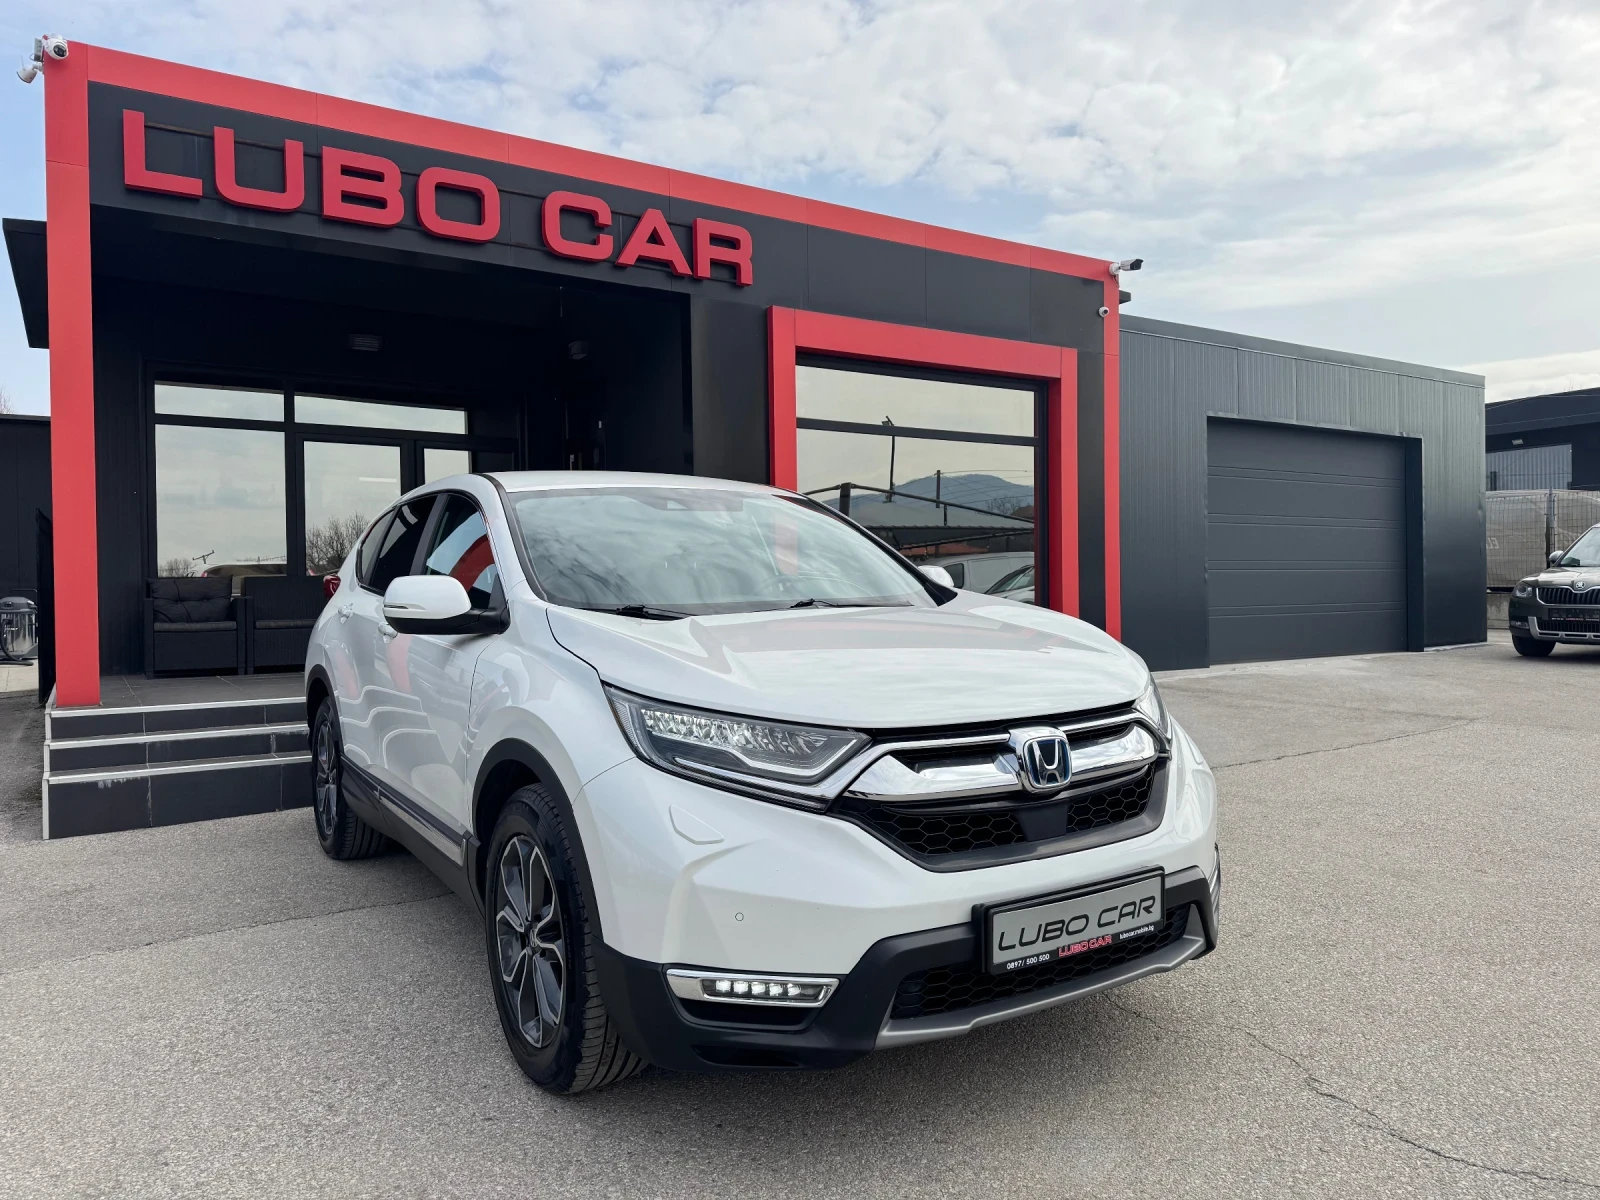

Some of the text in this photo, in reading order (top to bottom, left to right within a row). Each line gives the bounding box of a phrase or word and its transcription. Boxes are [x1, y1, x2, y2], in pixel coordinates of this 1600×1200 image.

[122, 108, 753, 287] LUBO CAR
[998, 895, 1156, 951] LUBO CAR
[1058, 935, 1112, 957] LUBO CAR
